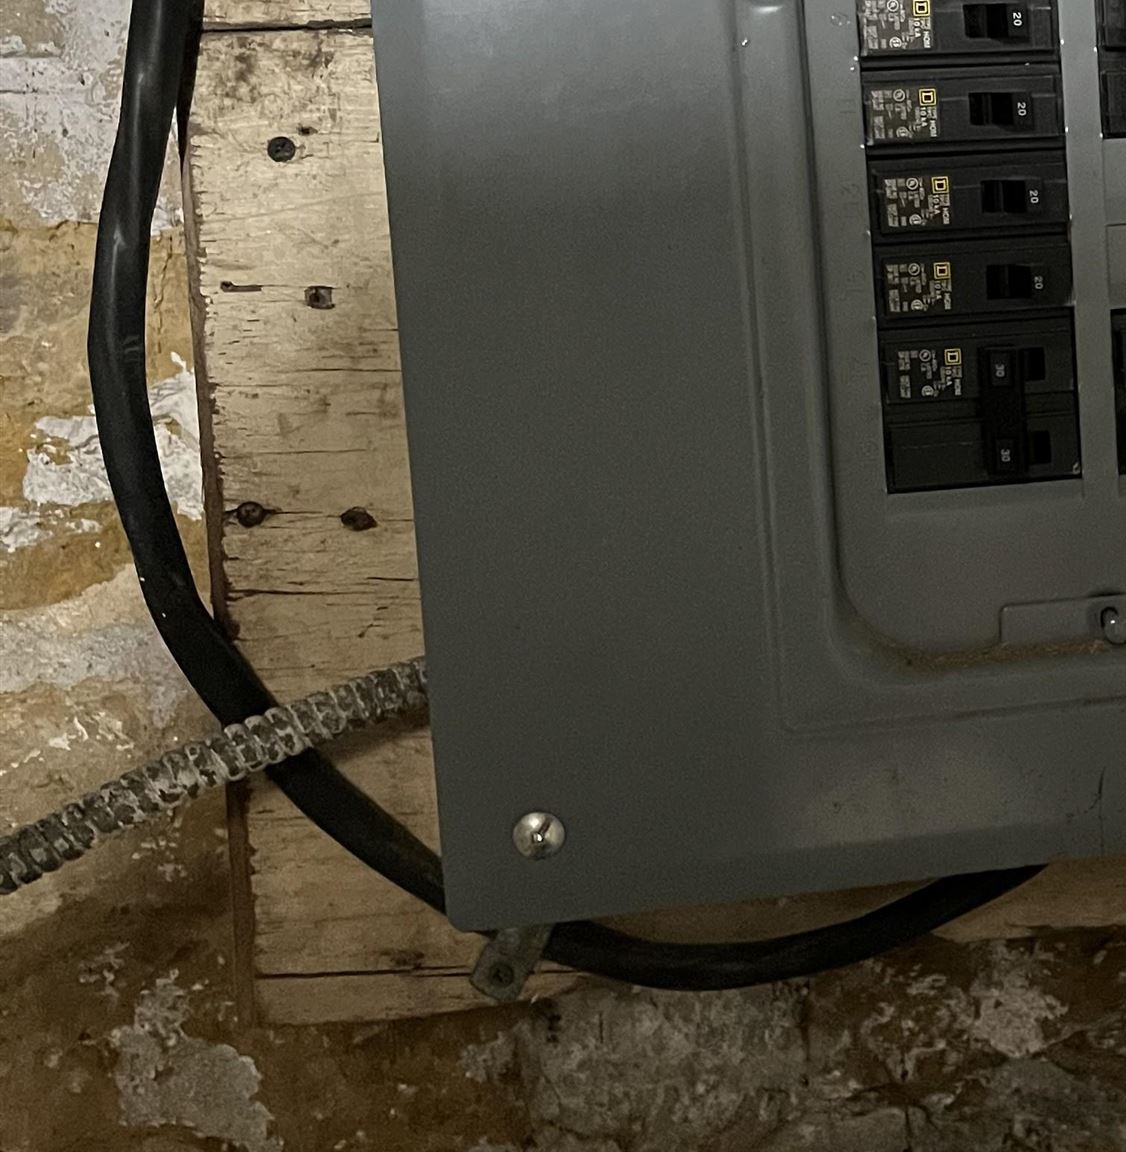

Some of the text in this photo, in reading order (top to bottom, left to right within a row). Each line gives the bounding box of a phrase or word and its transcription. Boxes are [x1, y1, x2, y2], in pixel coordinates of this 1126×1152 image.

[914, 18, 920, 27] 10
[1012, 11, 1023, 27] 20
[920, 107, 926, 115] 10
[1017, 101, 1027, 117] 20
[932, 194, 938, 204] 10
[1029, 189, 1039, 204] 20
[1034, 275, 1044, 291] 20
